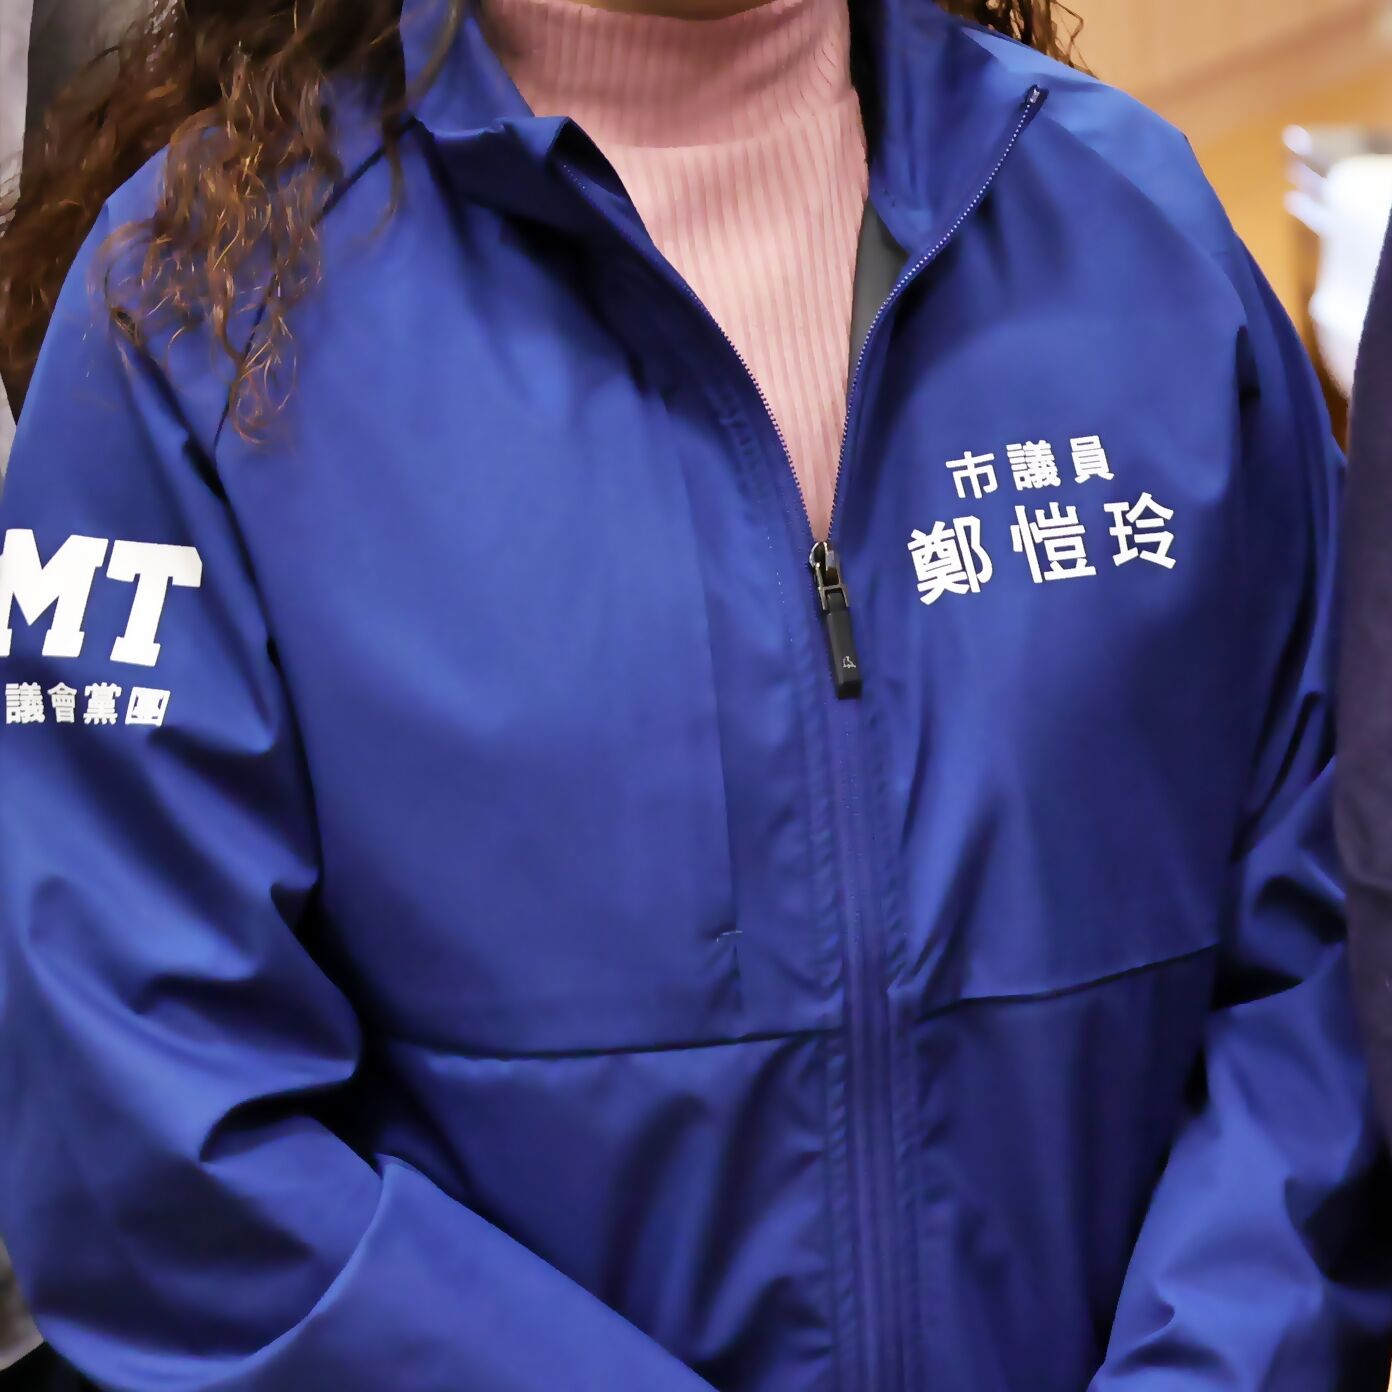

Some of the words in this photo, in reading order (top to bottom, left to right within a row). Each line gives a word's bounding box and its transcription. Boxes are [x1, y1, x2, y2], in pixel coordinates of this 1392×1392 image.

[945, 435, 1115, 499] 市議員
[907, 492, 1176, 606] 鄭愷玲
